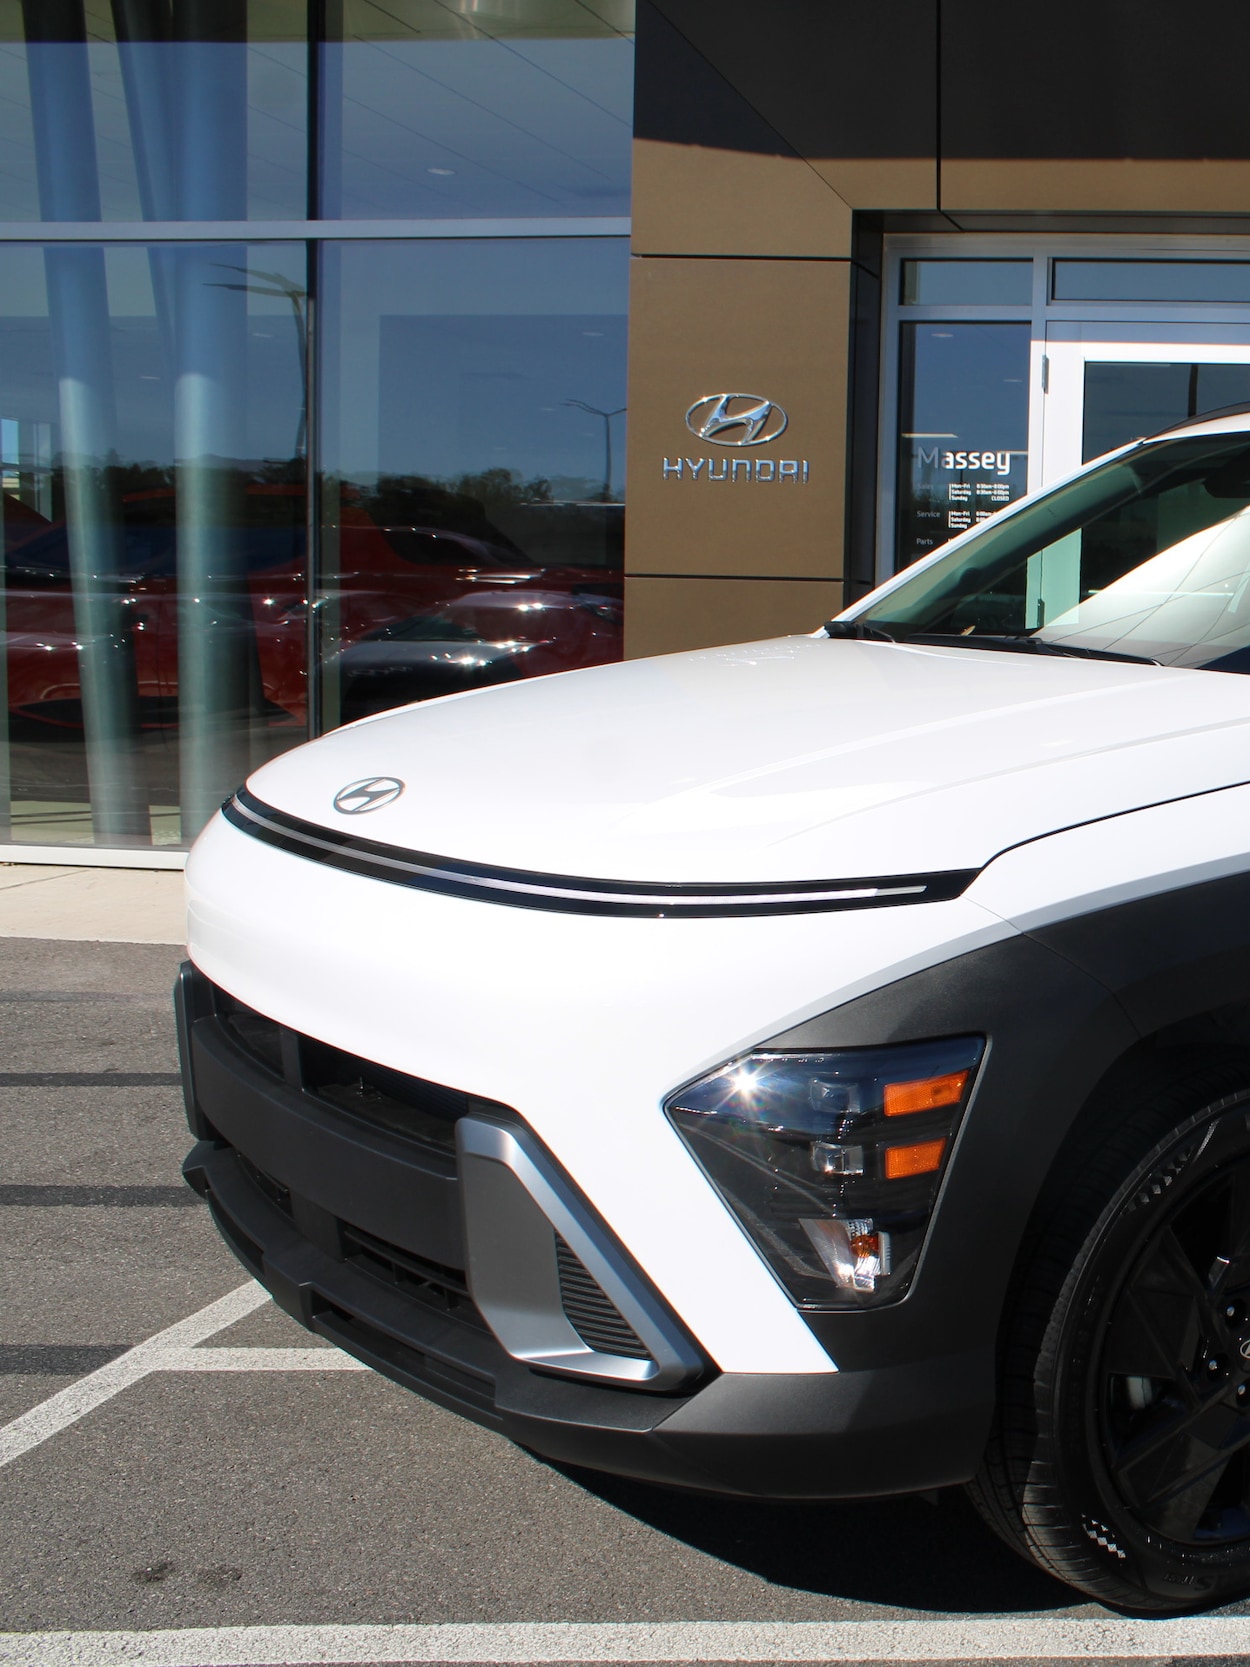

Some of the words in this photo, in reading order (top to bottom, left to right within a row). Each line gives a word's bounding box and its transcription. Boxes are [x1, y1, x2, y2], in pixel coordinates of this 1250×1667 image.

[662, 457, 809, 484] HYUNDAI
[917, 447, 1010, 476] Massey
[916, 510, 941, 518] Service
